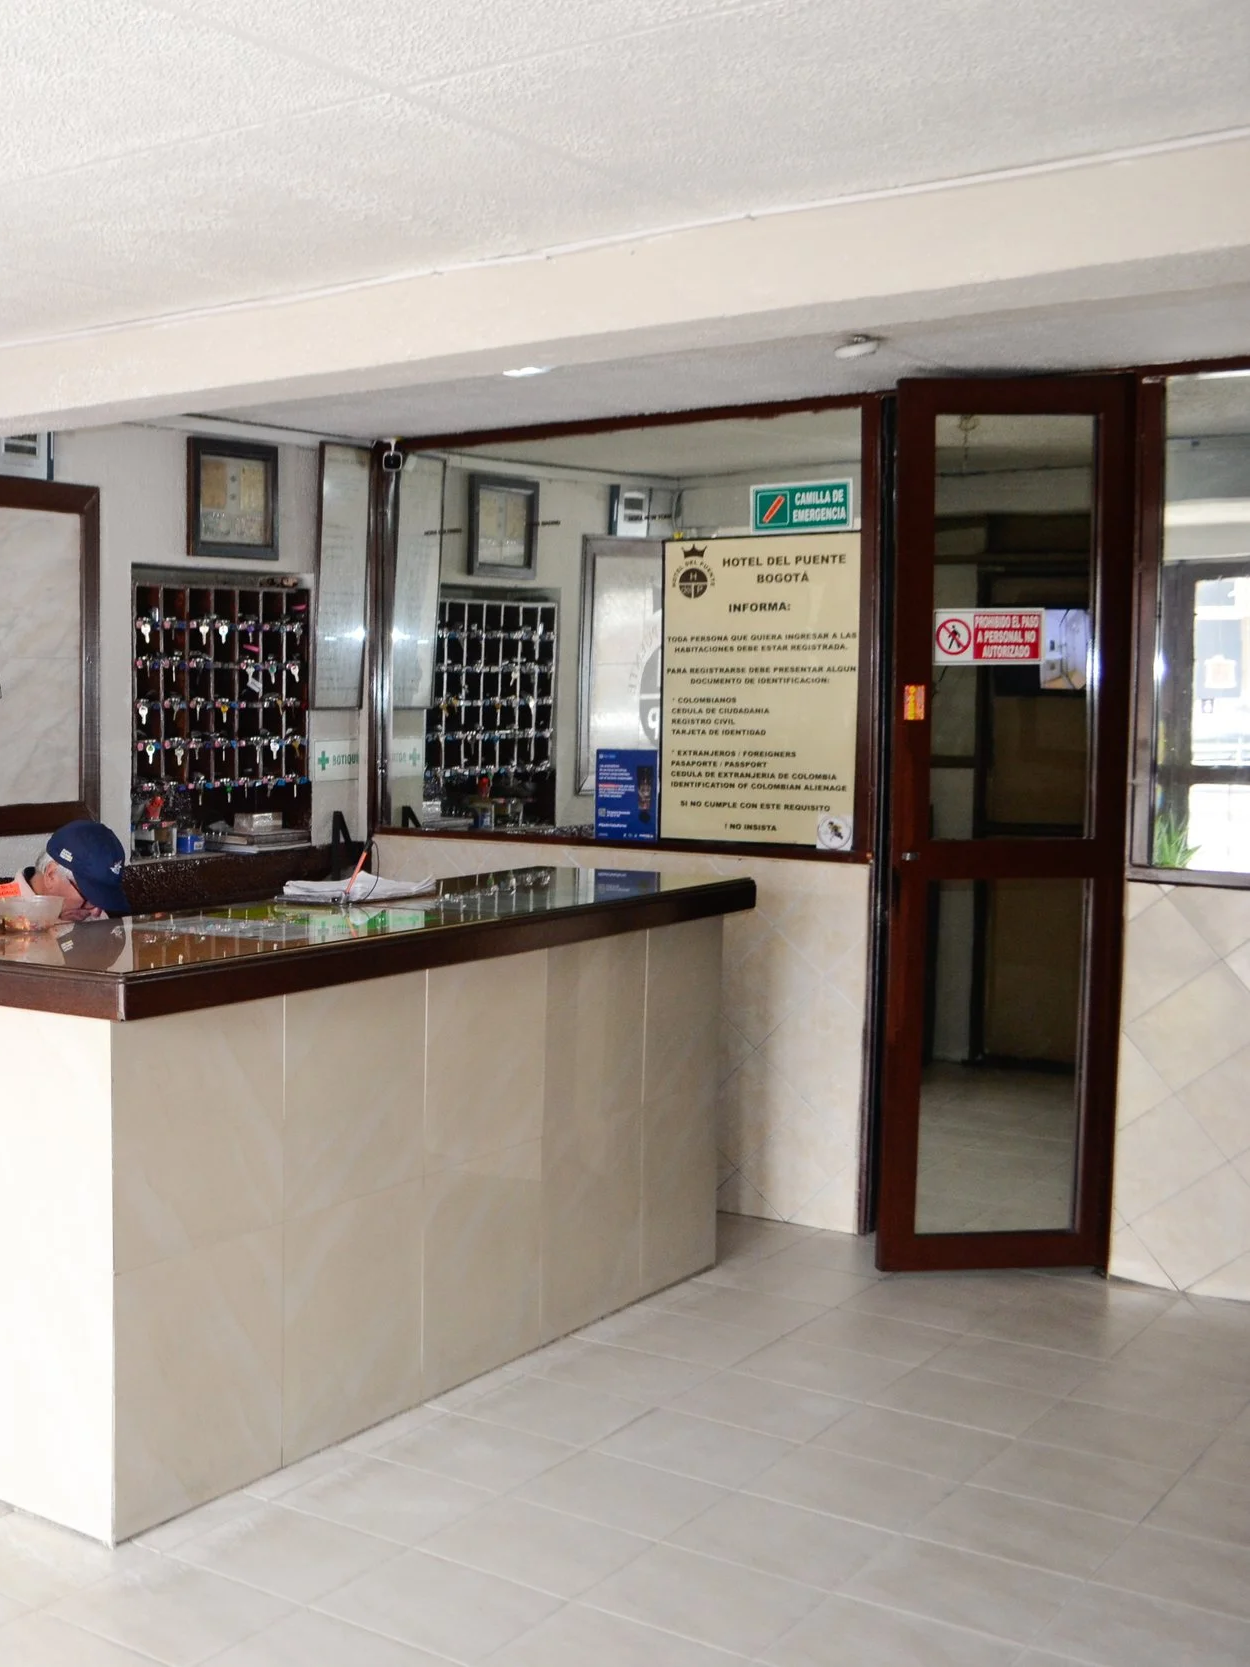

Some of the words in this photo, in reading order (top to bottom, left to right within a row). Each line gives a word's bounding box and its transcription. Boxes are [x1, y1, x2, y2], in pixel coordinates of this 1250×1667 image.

[795, 490, 831, 504] CAMILLA
[833, 489, 844, 502] DE
[793, 506, 847, 523] EMERGENCIA
[722, 556, 763, 568] HOTEL
[767, 555, 791, 566] DEL
[795, 554, 847, 565] PUENTE
[756, 570, 810, 584] BOGOTÁ
[728, 602, 791, 613] INFORMA:
[975, 615, 1010, 628] PROHIBIDO
[1012, 616, 1020, 628] EL
[1022, 616, 1039, 628] PASO
[730, 634, 748, 642] QUE
[750, 633, 782, 641] QUIERA
[785, 632, 829, 640] INGRESAR
[840, 631, 857, 639] LAS
[977, 631, 982, 642] A
[984, 631, 1023, 643] PERSONAL
[1025, 631, 1036, 643] NO
[761, 644, 788, 652] ESTAR
[982, 645, 1030, 658] AUTORIZADO
[689, 666, 746, 674] REGISTRARSE
[826, 665, 857, 673] ALGUN
[677, 749, 737, 757] EXTRANJEROS
[332, 753, 359, 766] BOTIQU
[718, 771, 776, 779] EXTRANJERIA
[670, 781, 736, 789] IDENTIFICATION
[751, 783, 801, 791] COLOMBIAN
[803, 784, 847, 792] ALIENAGE
[704, 801, 737, 809] CUMPLE
[740, 802, 758, 810] CON
[784, 804, 831, 812] REQUISITO
